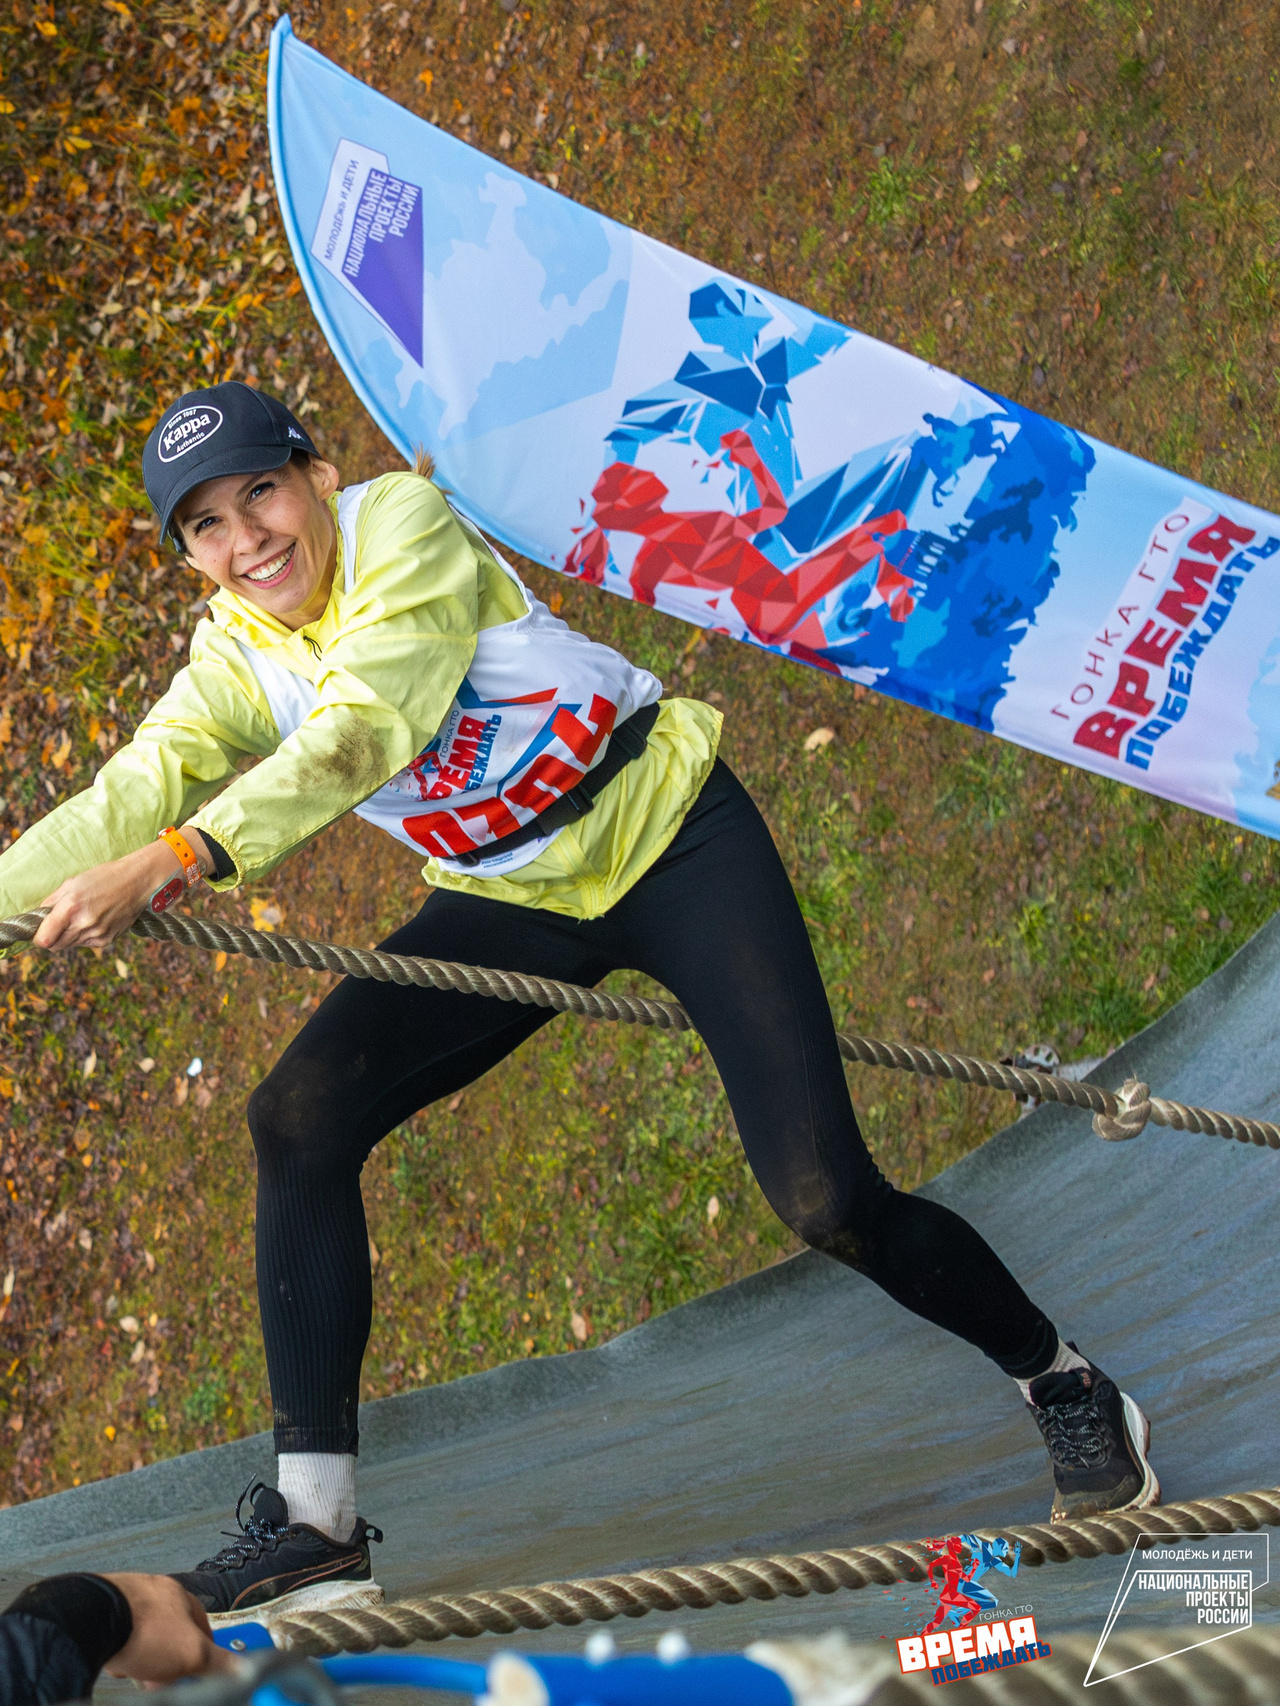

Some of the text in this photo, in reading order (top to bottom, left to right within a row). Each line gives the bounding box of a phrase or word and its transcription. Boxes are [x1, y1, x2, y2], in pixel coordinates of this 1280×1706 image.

[341, 191, 349, 200] И
[342, 159, 359, 192] ДЕТИ
[343, 171, 387, 278] НАЦИОНАЛЬНЫЕ
[368, 177, 404, 243] ПРОЕКТЫ
[388, 184, 420, 238] РОССИИ
[163, 414, 211, 451] Kappa
[177, 432, 205, 453] Authentic
[1051, 514, 1190, 720] ГОНКА ГТО
[1073, 514, 1257, 760] ВРЕМЯ
[1125, 536, 1280, 771] ПОБЕЖДАТЬ
[427, 715, 490, 800] РЕМЯ
[440, 709, 460, 758] ГОНКА ГТО
[463, 714, 502, 794] БЕЖДАТЬ
